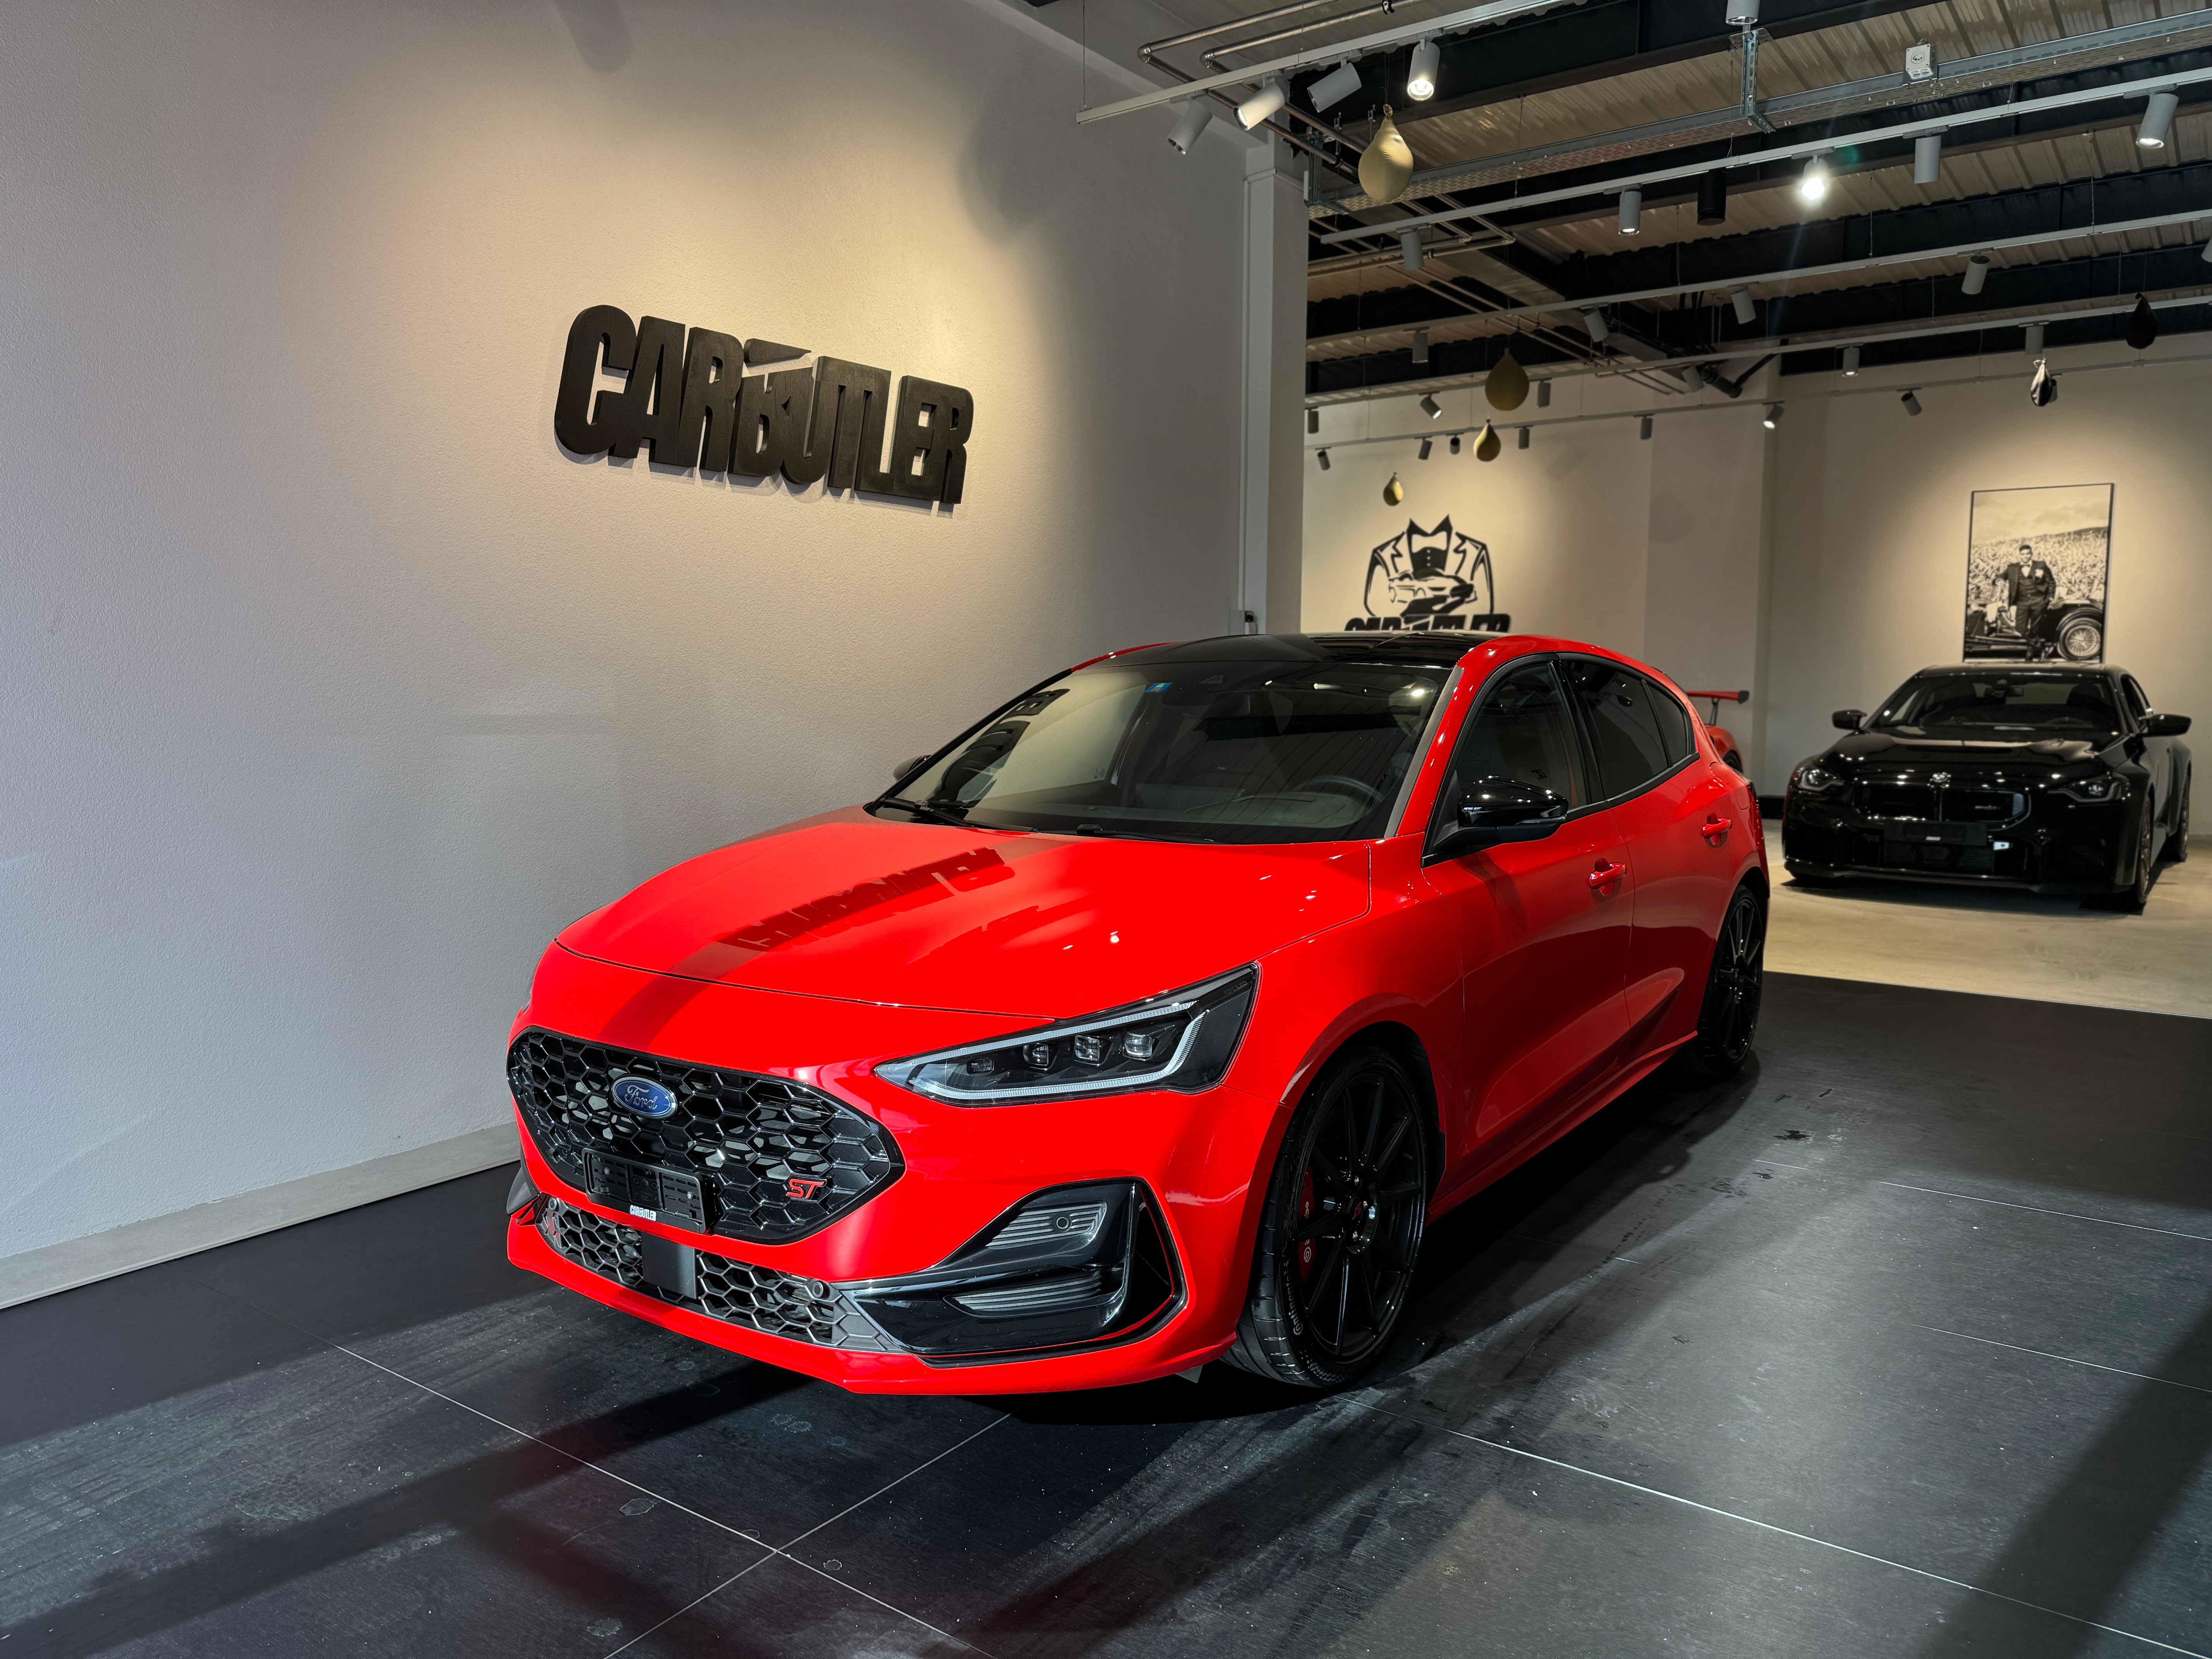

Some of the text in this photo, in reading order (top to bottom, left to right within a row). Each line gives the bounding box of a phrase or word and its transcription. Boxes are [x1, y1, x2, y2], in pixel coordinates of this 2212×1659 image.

[554, 304, 974, 504] CARBUTLER
[624, 1085, 658, 1109] Ford
[786, 1178, 824, 1199] ST
[630, 1204, 657, 1221] CARBUTLER
